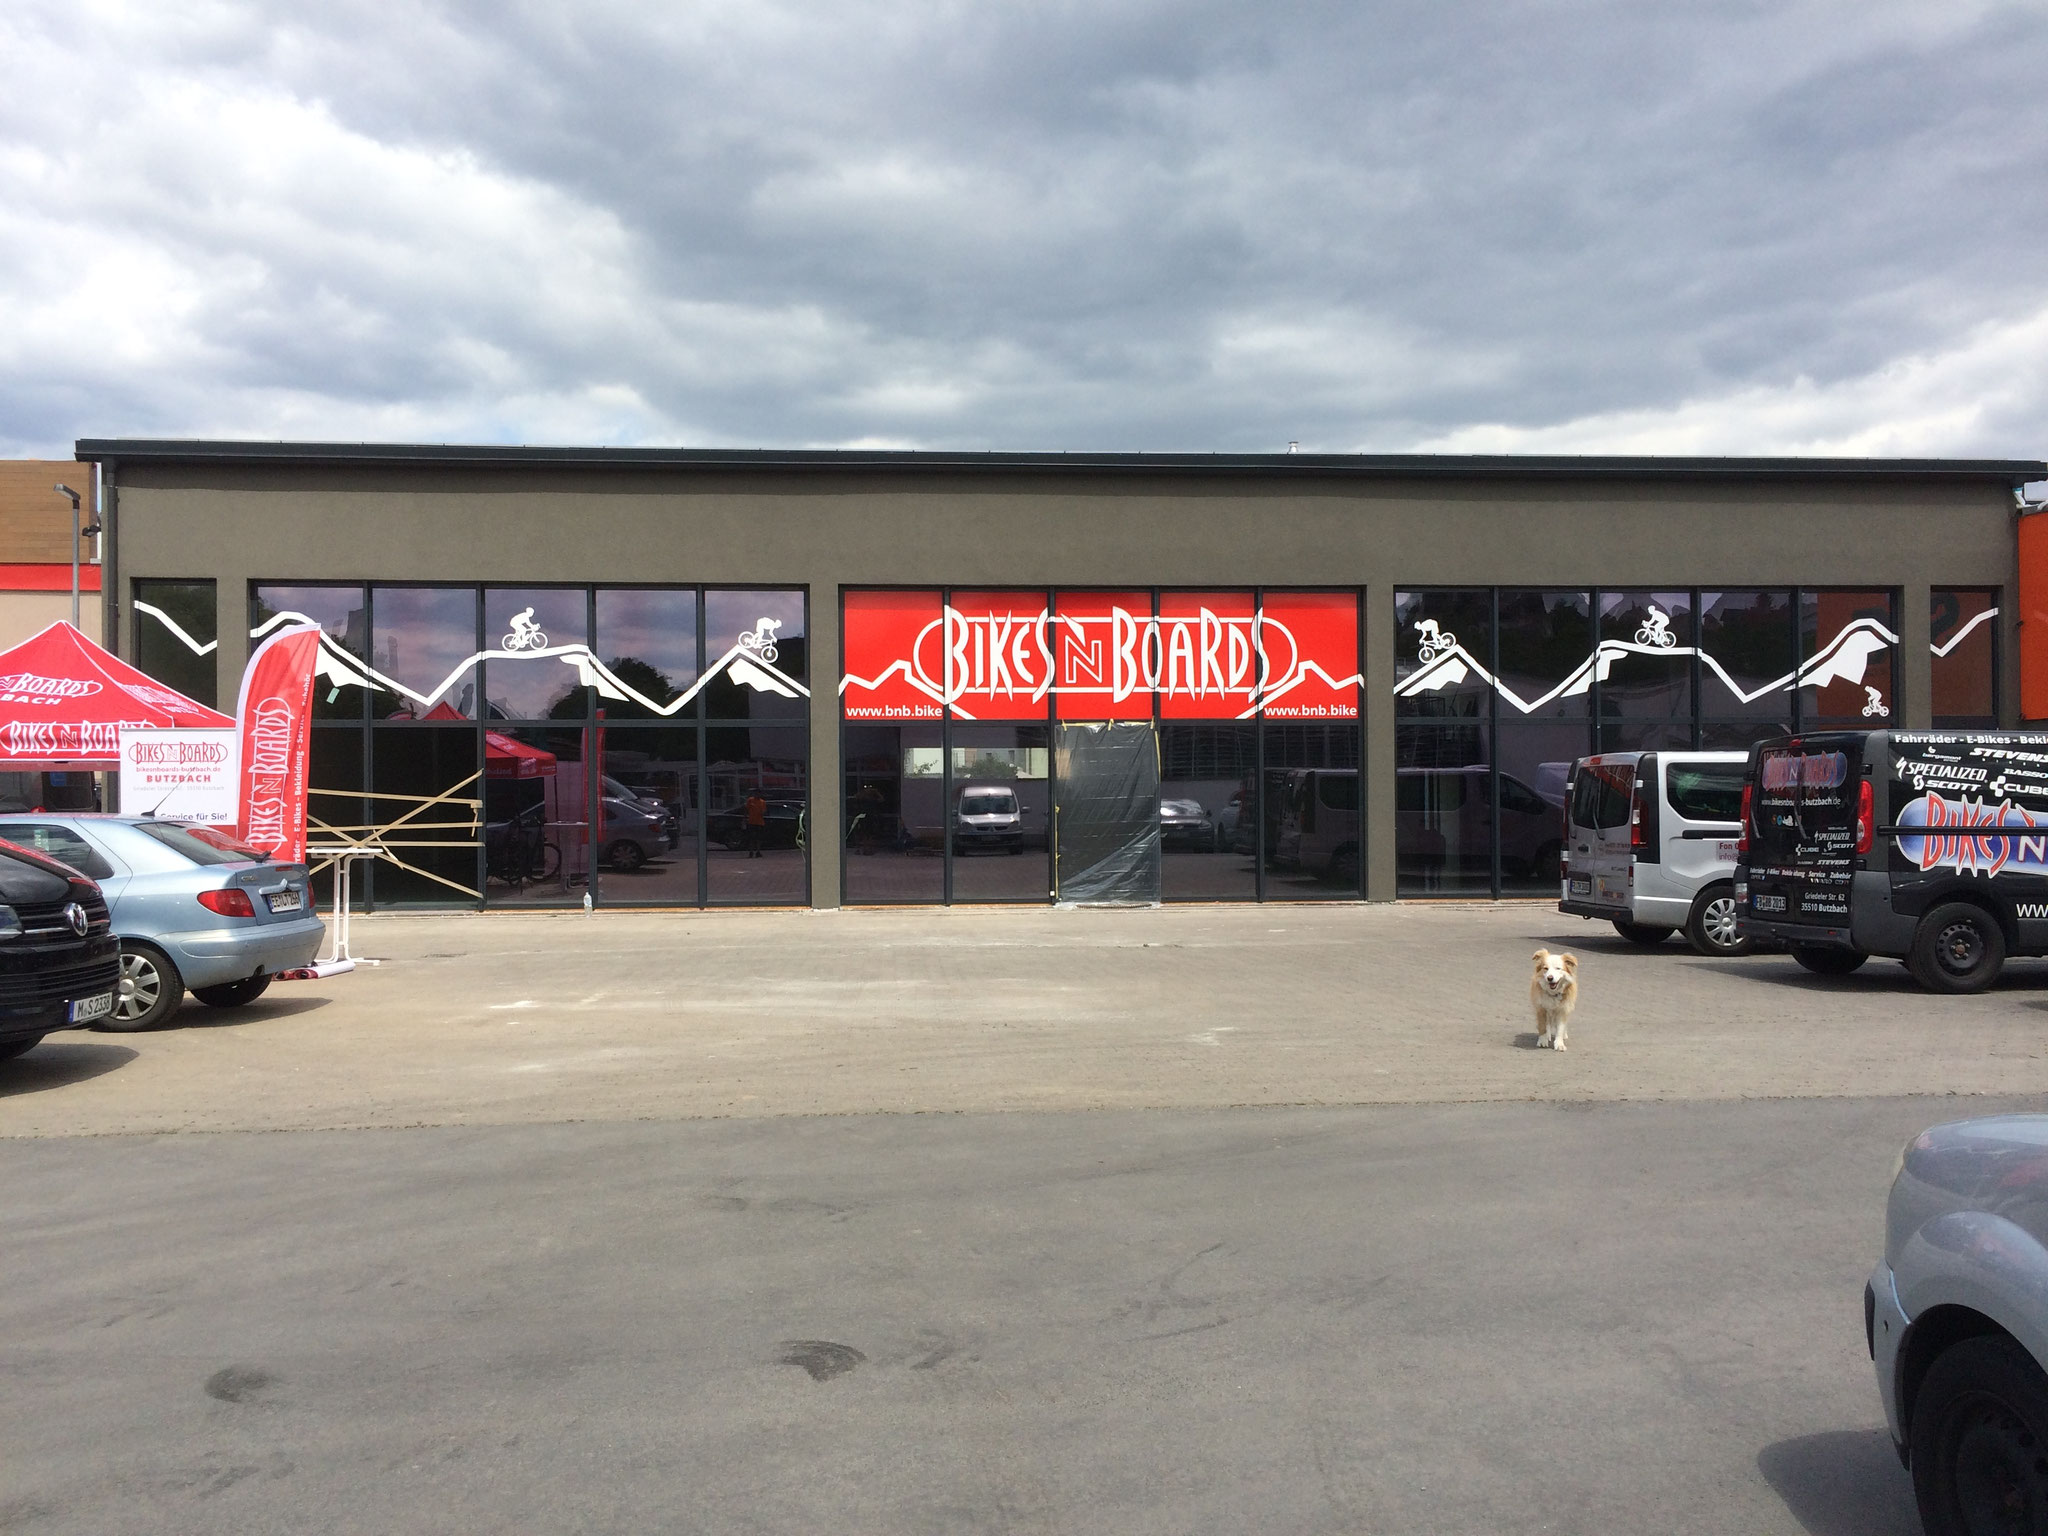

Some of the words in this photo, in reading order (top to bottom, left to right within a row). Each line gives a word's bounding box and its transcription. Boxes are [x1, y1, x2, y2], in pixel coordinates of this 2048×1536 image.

[1112, 606, 1270, 704] BOARDS
[846, 704, 943, 717] www.bnb.bike
[1264, 704, 1357, 717] www.bnb.bike
[9, 720, 57, 756] BIKES
[248, 708, 296, 774] BOARDS
[1895, 734, 1957, 744] Fahrräder
[1966, 734, 2011, 744] E-Bikes
[2020, 735, 2048, 744] Bekl
[136, 741, 165, 765] BIKES
[180, 741, 221, 765] BOARDS
[1969, 747, 2048, 763] STEVENS
[1905, 762, 1988, 781] SPECIALIZED
[146, 775, 211, 783] BUTZBACH
[1925, 780, 1981, 792] SCOTT
[1801, 902, 1818, 912] 35510
[1818, 903, 1848, 913] Butzbach
